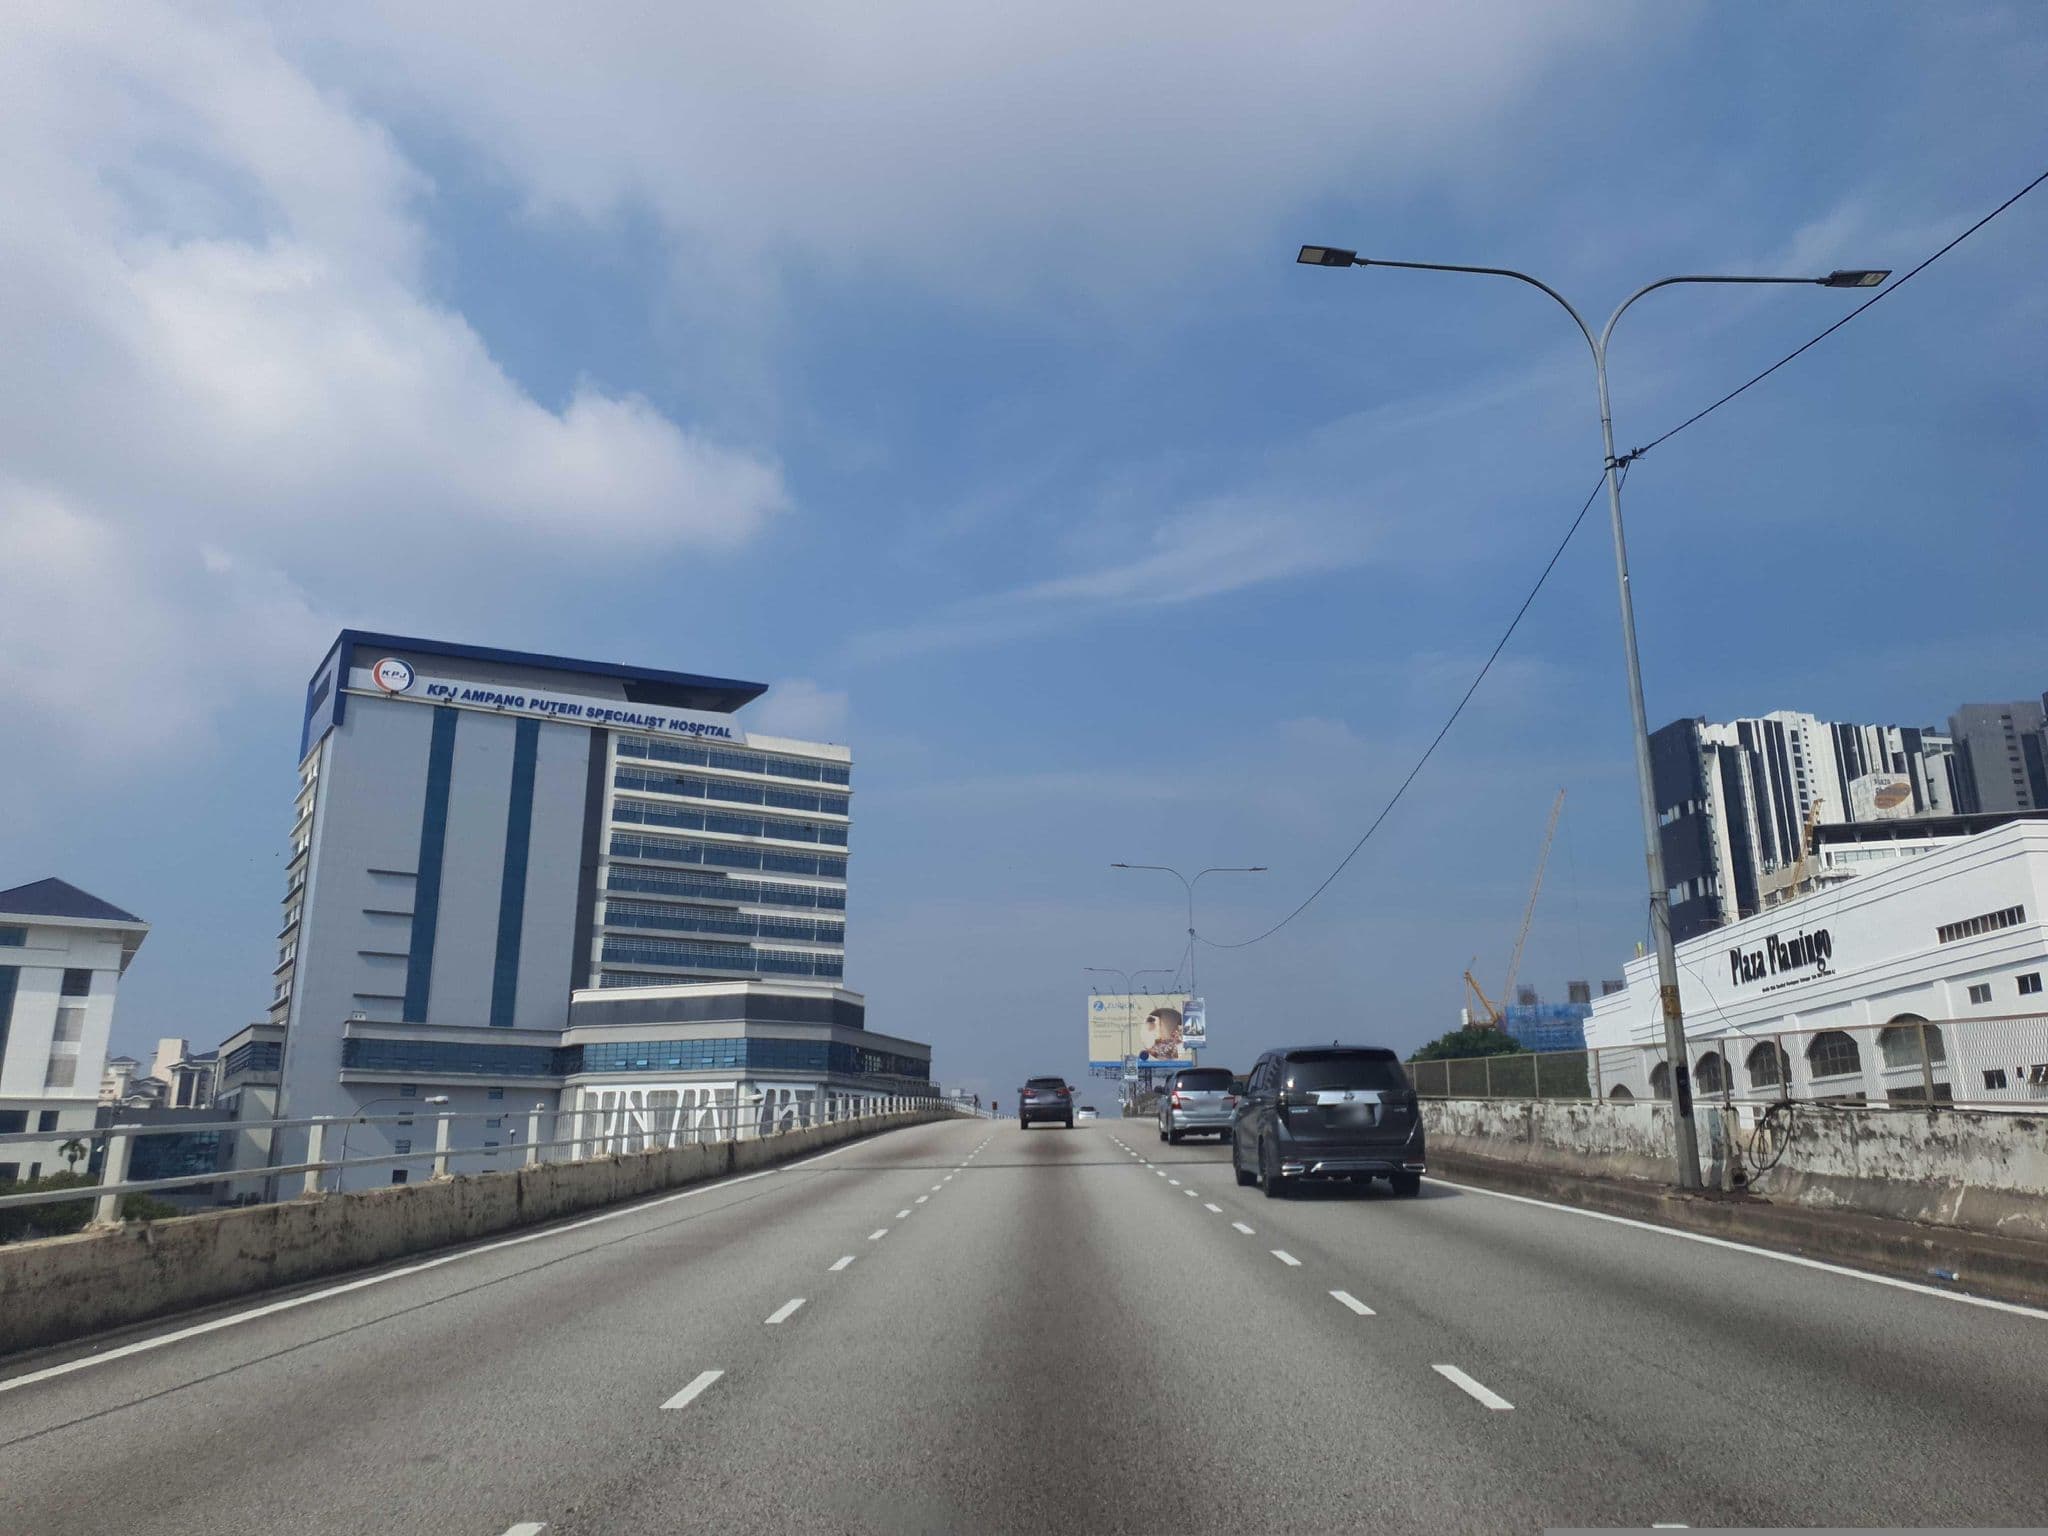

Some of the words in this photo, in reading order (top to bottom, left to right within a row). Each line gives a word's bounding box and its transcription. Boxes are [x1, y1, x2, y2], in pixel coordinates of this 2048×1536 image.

[382, 669, 407, 679] KPJ
[426, 684, 458, 699] KPJ
[460, 688, 525, 708] AMPANG
[529, 698, 583, 716] PUTERI
[585, 706, 666, 729] SPECIALIST
[669, 719, 732, 738] HOSPITAL
[1729, 947, 1767, 987] Plaza
[1766, 929, 1832, 973] Flamingo
